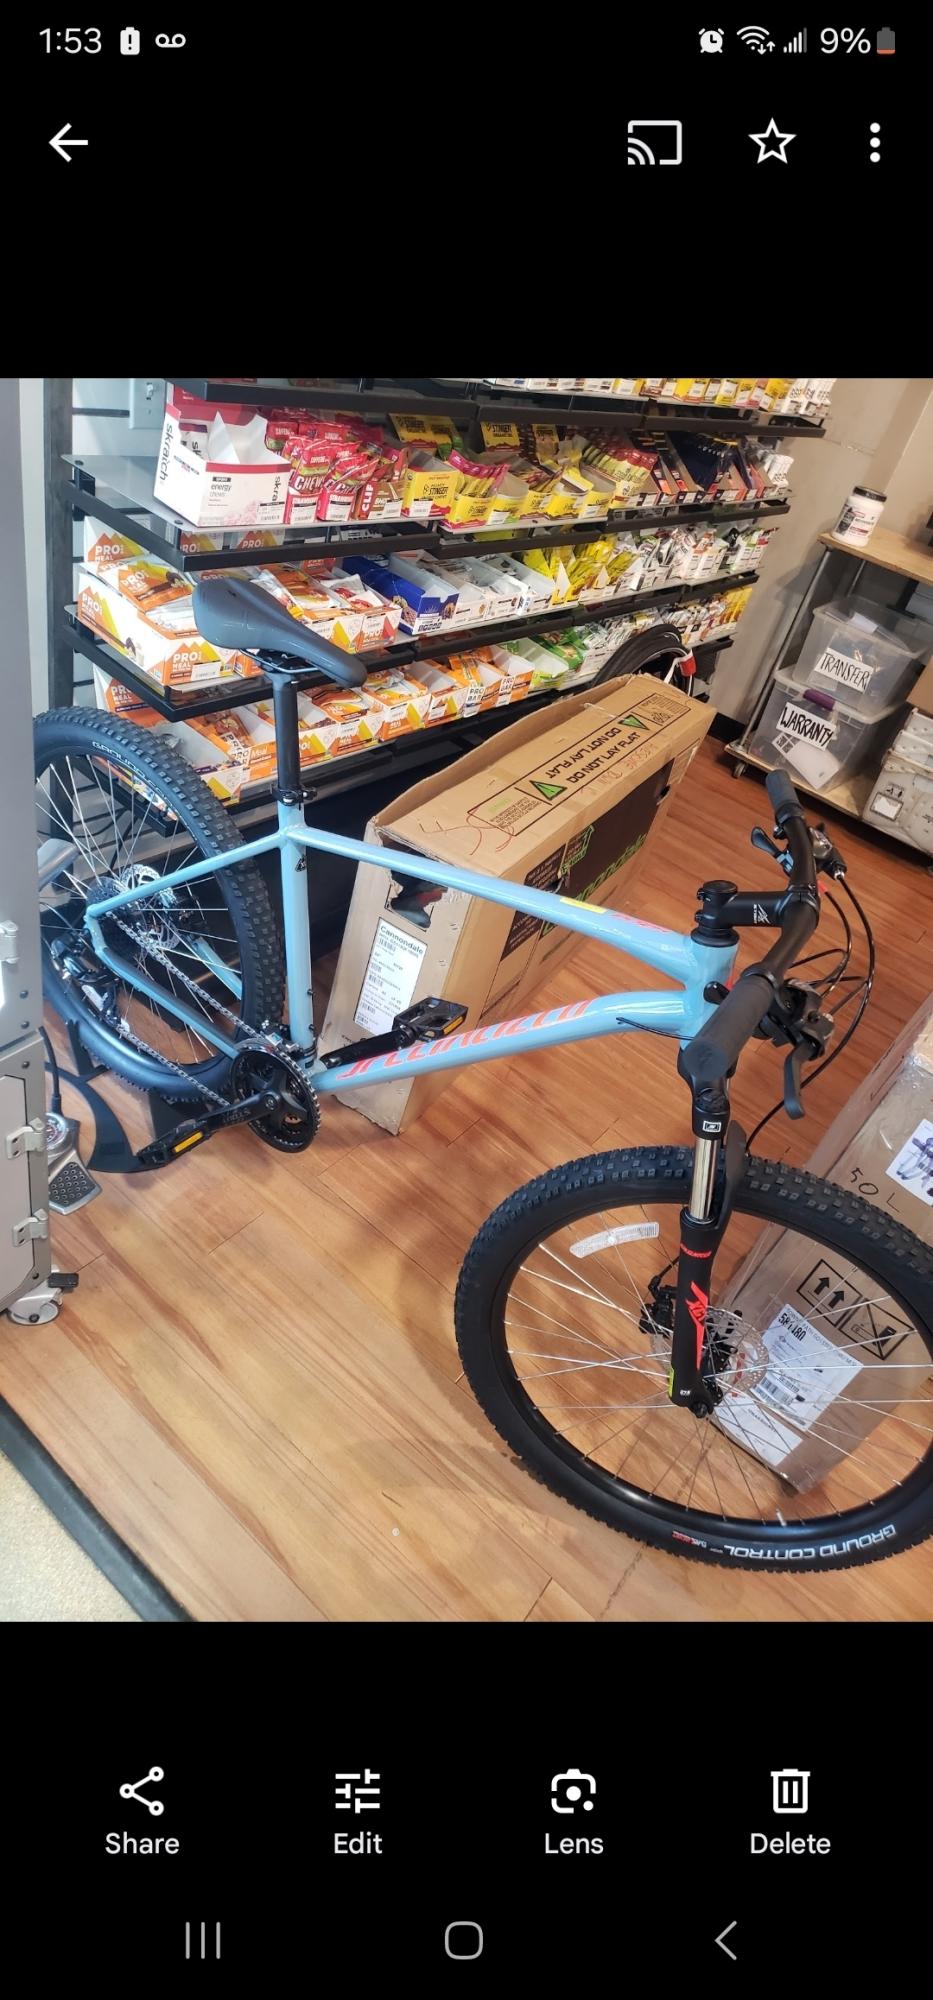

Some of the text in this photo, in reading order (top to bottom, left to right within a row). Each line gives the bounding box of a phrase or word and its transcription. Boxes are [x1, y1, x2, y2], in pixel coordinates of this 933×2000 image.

[210, 484, 232, 492] energy
[362, 484, 374, 512] CLIF
[429, 487, 448, 495] STINGER
[95, 545, 121, 553] PRO
[242, 540, 262, 548] PRO
[173, 652, 198, 662] PRO
[820, 653, 870, 690] TRANSFER
[780, 707, 834, 750] WARRANTY
[546, 727, 622, 778] DO NOT LAY FLAT
[567, 732, 640, 784] DO NOT LAY FLAT
[380, 926, 424, 954] Cannondale
[849, 1167, 900, 1213] 50 L
[724, 1524, 897, 1560] GROUND CONTROL
